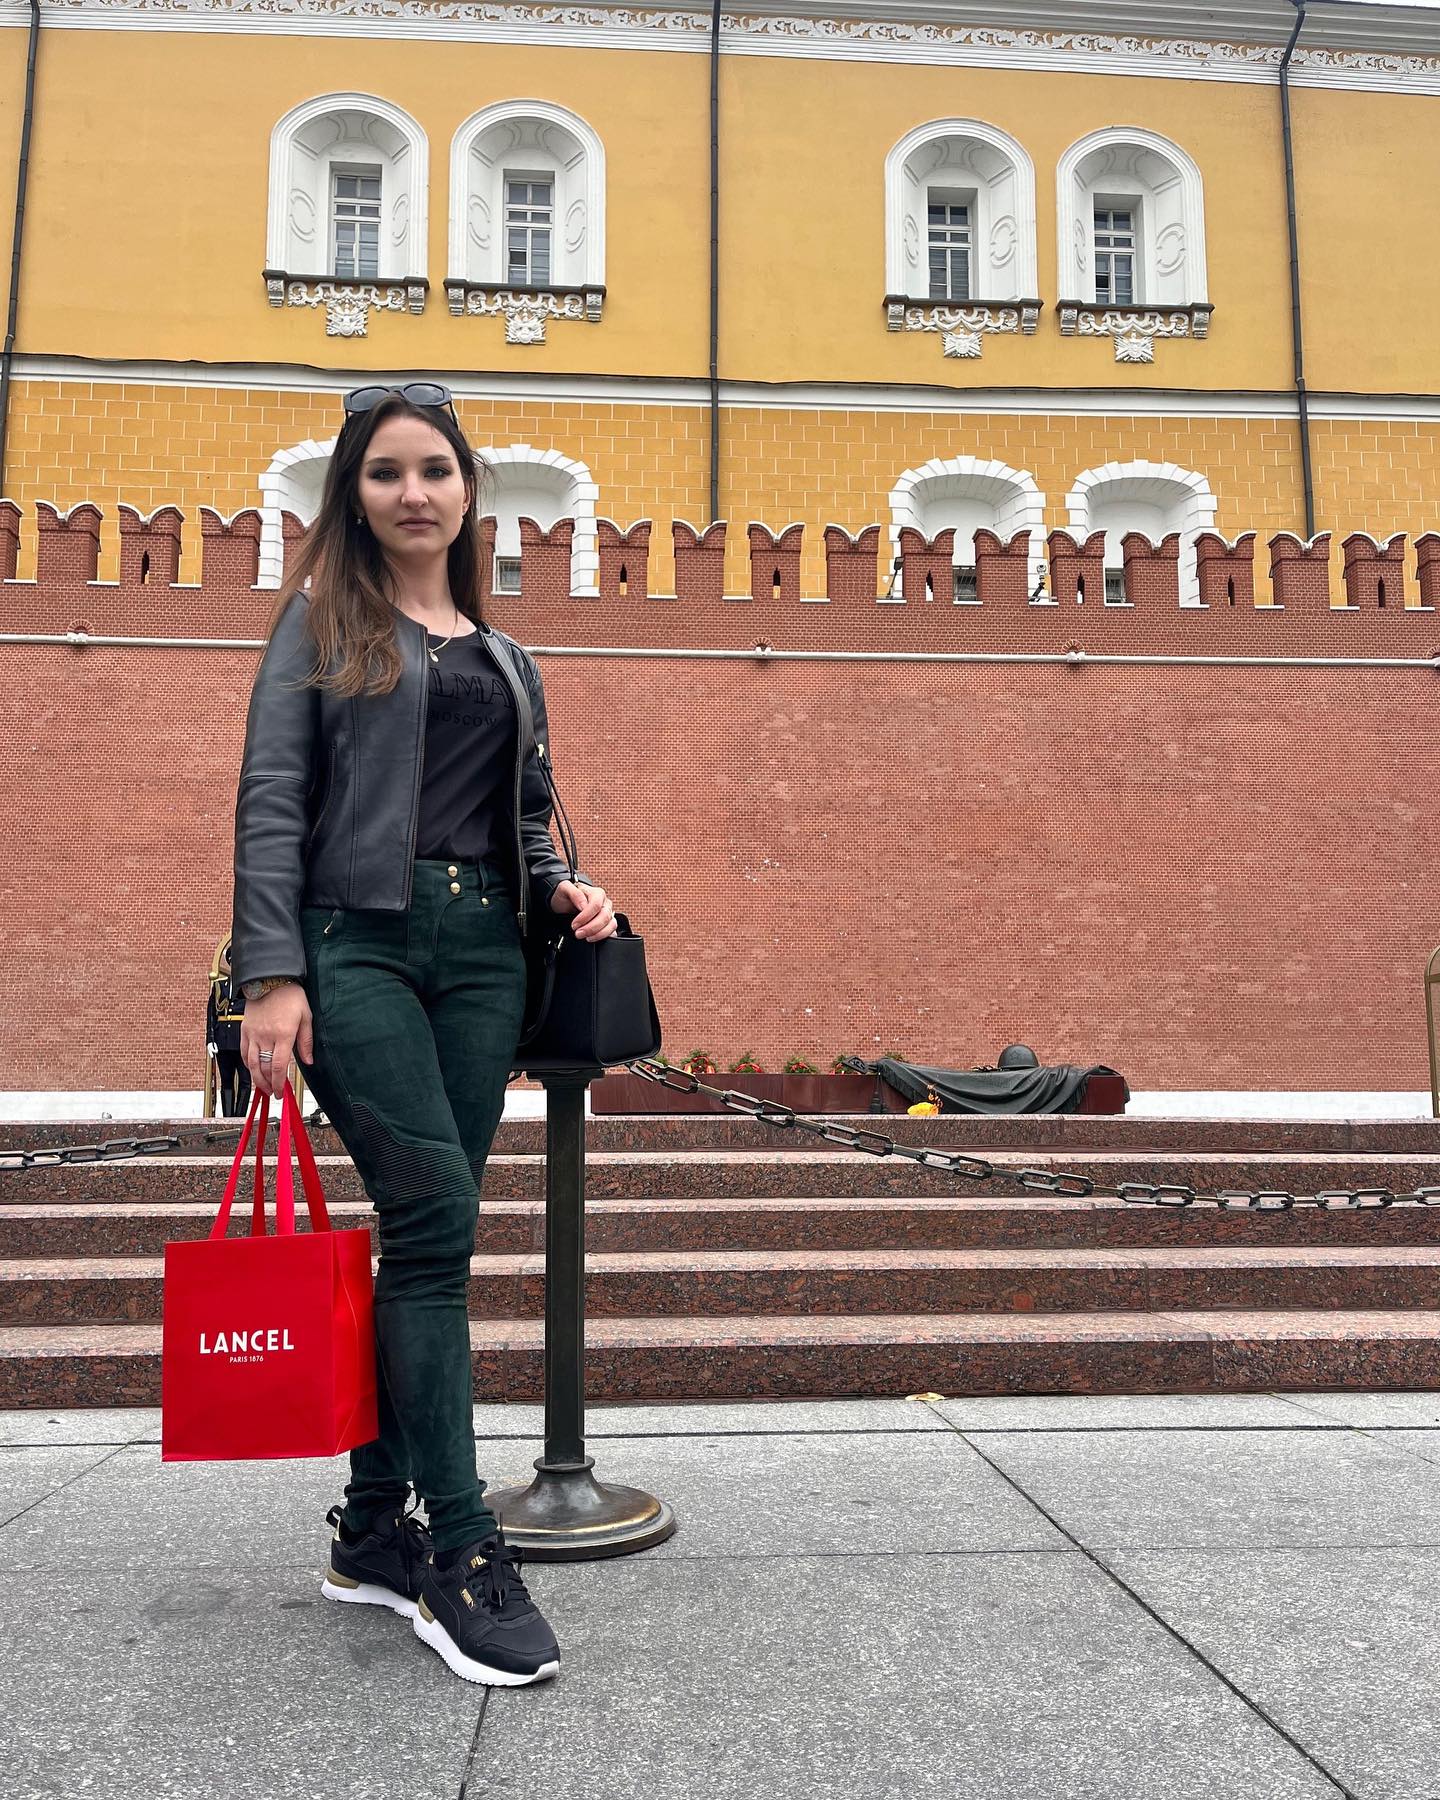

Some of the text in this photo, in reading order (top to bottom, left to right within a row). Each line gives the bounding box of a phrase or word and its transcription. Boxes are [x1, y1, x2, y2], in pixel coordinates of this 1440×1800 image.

[428, 667, 514, 708] LMA
[200, 1329, 294, 1354] LANCEL
[229, 1355, 264, 1364] PARIS 1876
